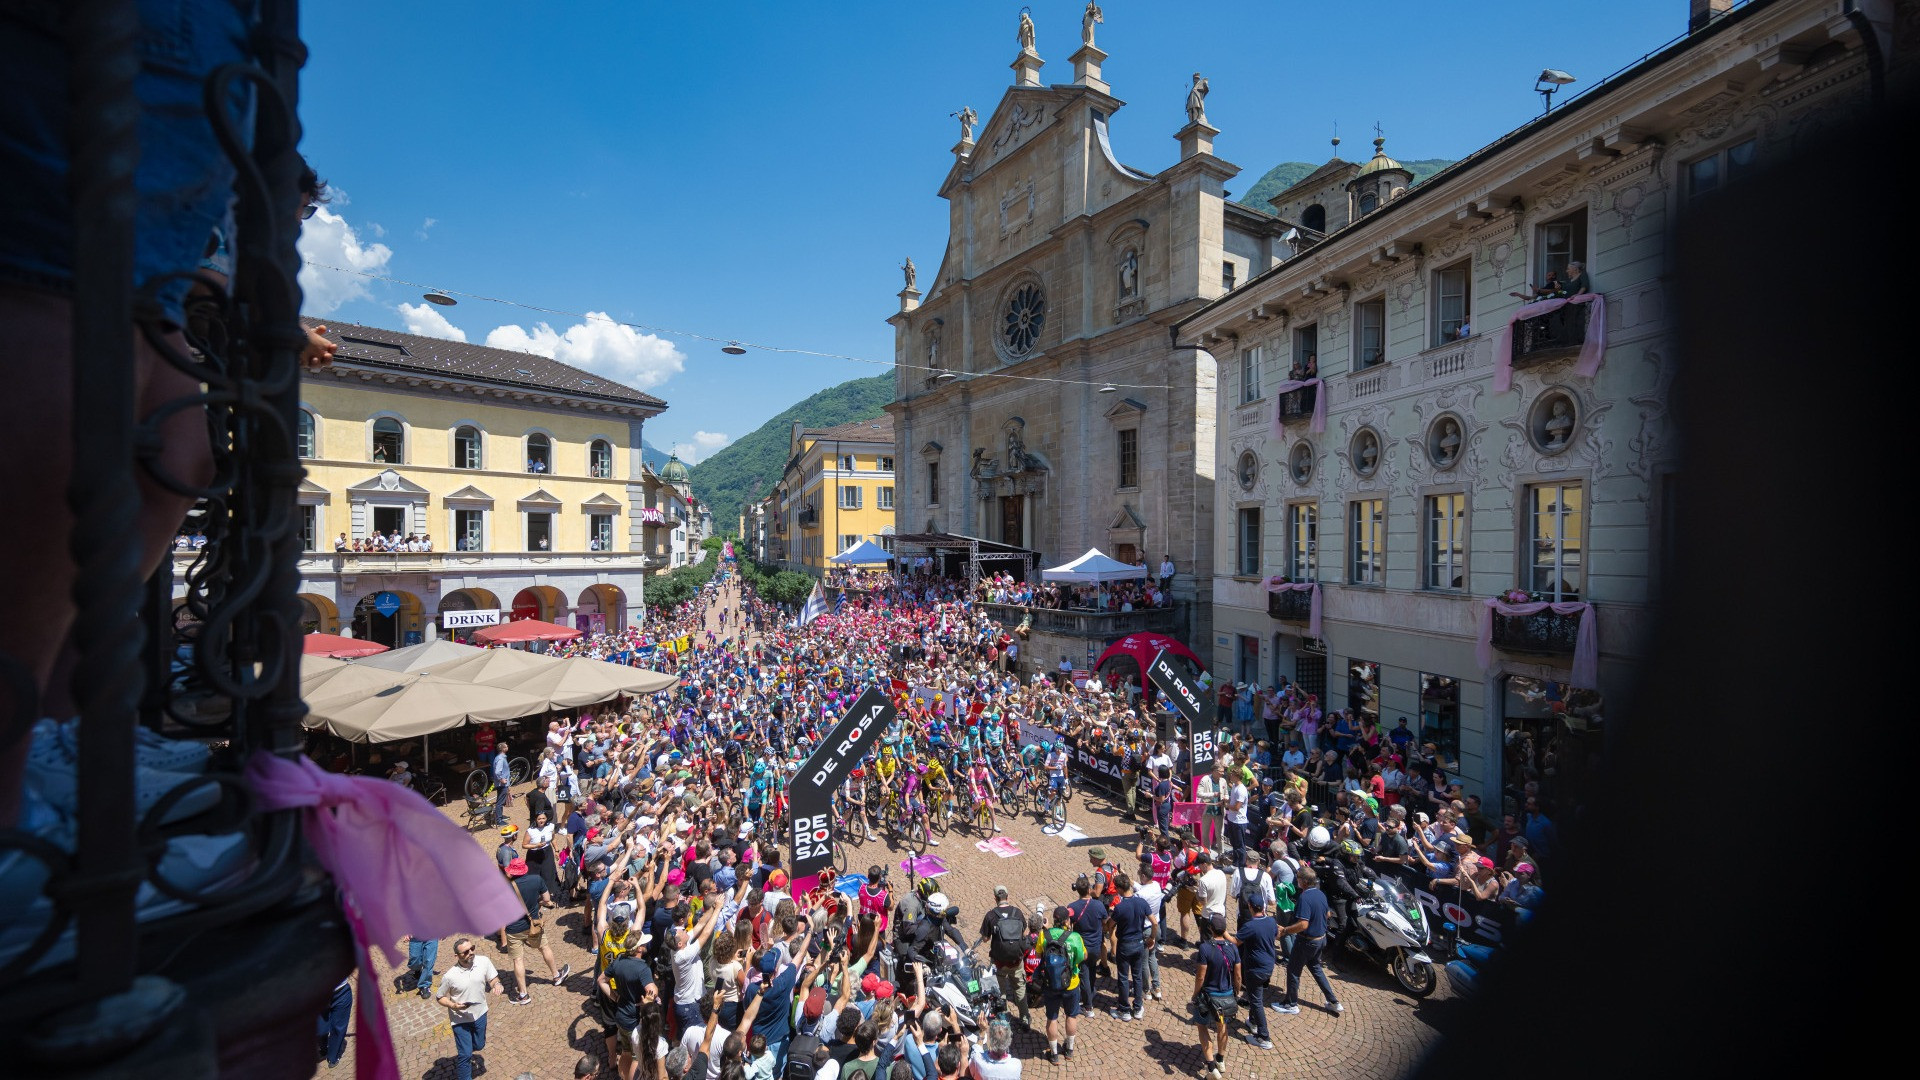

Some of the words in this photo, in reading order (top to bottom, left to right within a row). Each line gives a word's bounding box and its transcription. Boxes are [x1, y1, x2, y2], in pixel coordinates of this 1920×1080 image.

[449, 614, 496, 625] DRINK
[1158, 660, 1175, 680] DE
[1173, 677, 1201, 713] ROSA
[1193, 730, 1212, 743] DE
[812, 757, 838, 787] DE
[837, 705, 885, 757] ROSA
[1193, 741, 1213, 753] RO
[1078, 750, 1123, 780] ROSA
[1194, 751, 1213, 764] SA
[794, 813, 827, 833] DE
[795, 828, 830, 846] RO
[796, 843, 830, 861] SA
[1414, 887, 1502, 942] ROS
